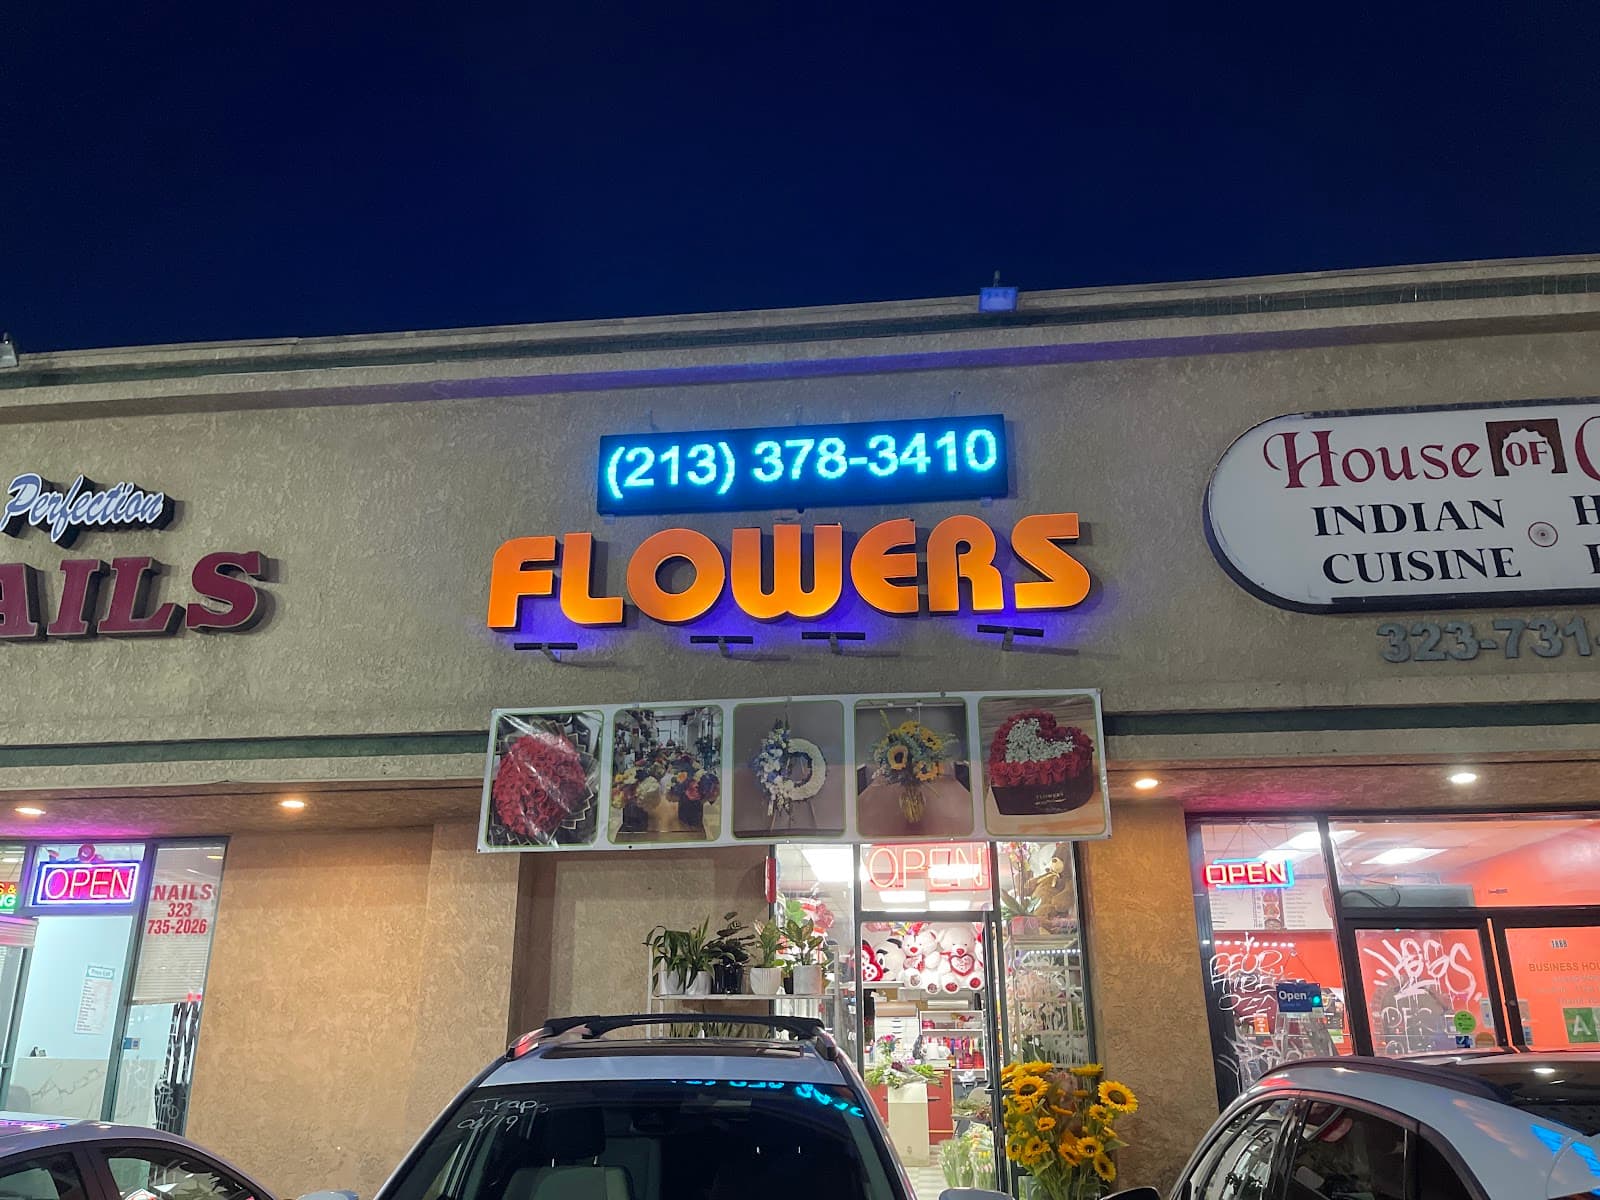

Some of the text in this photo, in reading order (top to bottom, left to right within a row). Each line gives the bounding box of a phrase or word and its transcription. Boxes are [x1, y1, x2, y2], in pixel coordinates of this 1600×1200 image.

[605, 429, 998, 498] (213) 378-3410
[1263, 430, 1483, 488] House
[1505, 441, 1548, 467] OF
[0, 473, 164, 542] Perfection
[1310, 499, 1505, 536] INDIAN
[487, 512, 1091, 628] FLOWERS
[1322, 547, 1522, 584] CUISINE
[1376, 616, 1600, 663] 323-731
[45, 868, 134, 899] OPEN
[870, 847, 983, 888] OPEN
[1205, 861, 1287, 884] OPEN
[153, 884, 212, 900] NAILS
[147, 919, 208, 935] 735-2026
[167, 902, 193, 918] 323
[1528, 962, 1579, 972] BUSINESS
[1279, 990, 1307, 1003] Open
[1572, 1014, 1593, 1036] A
